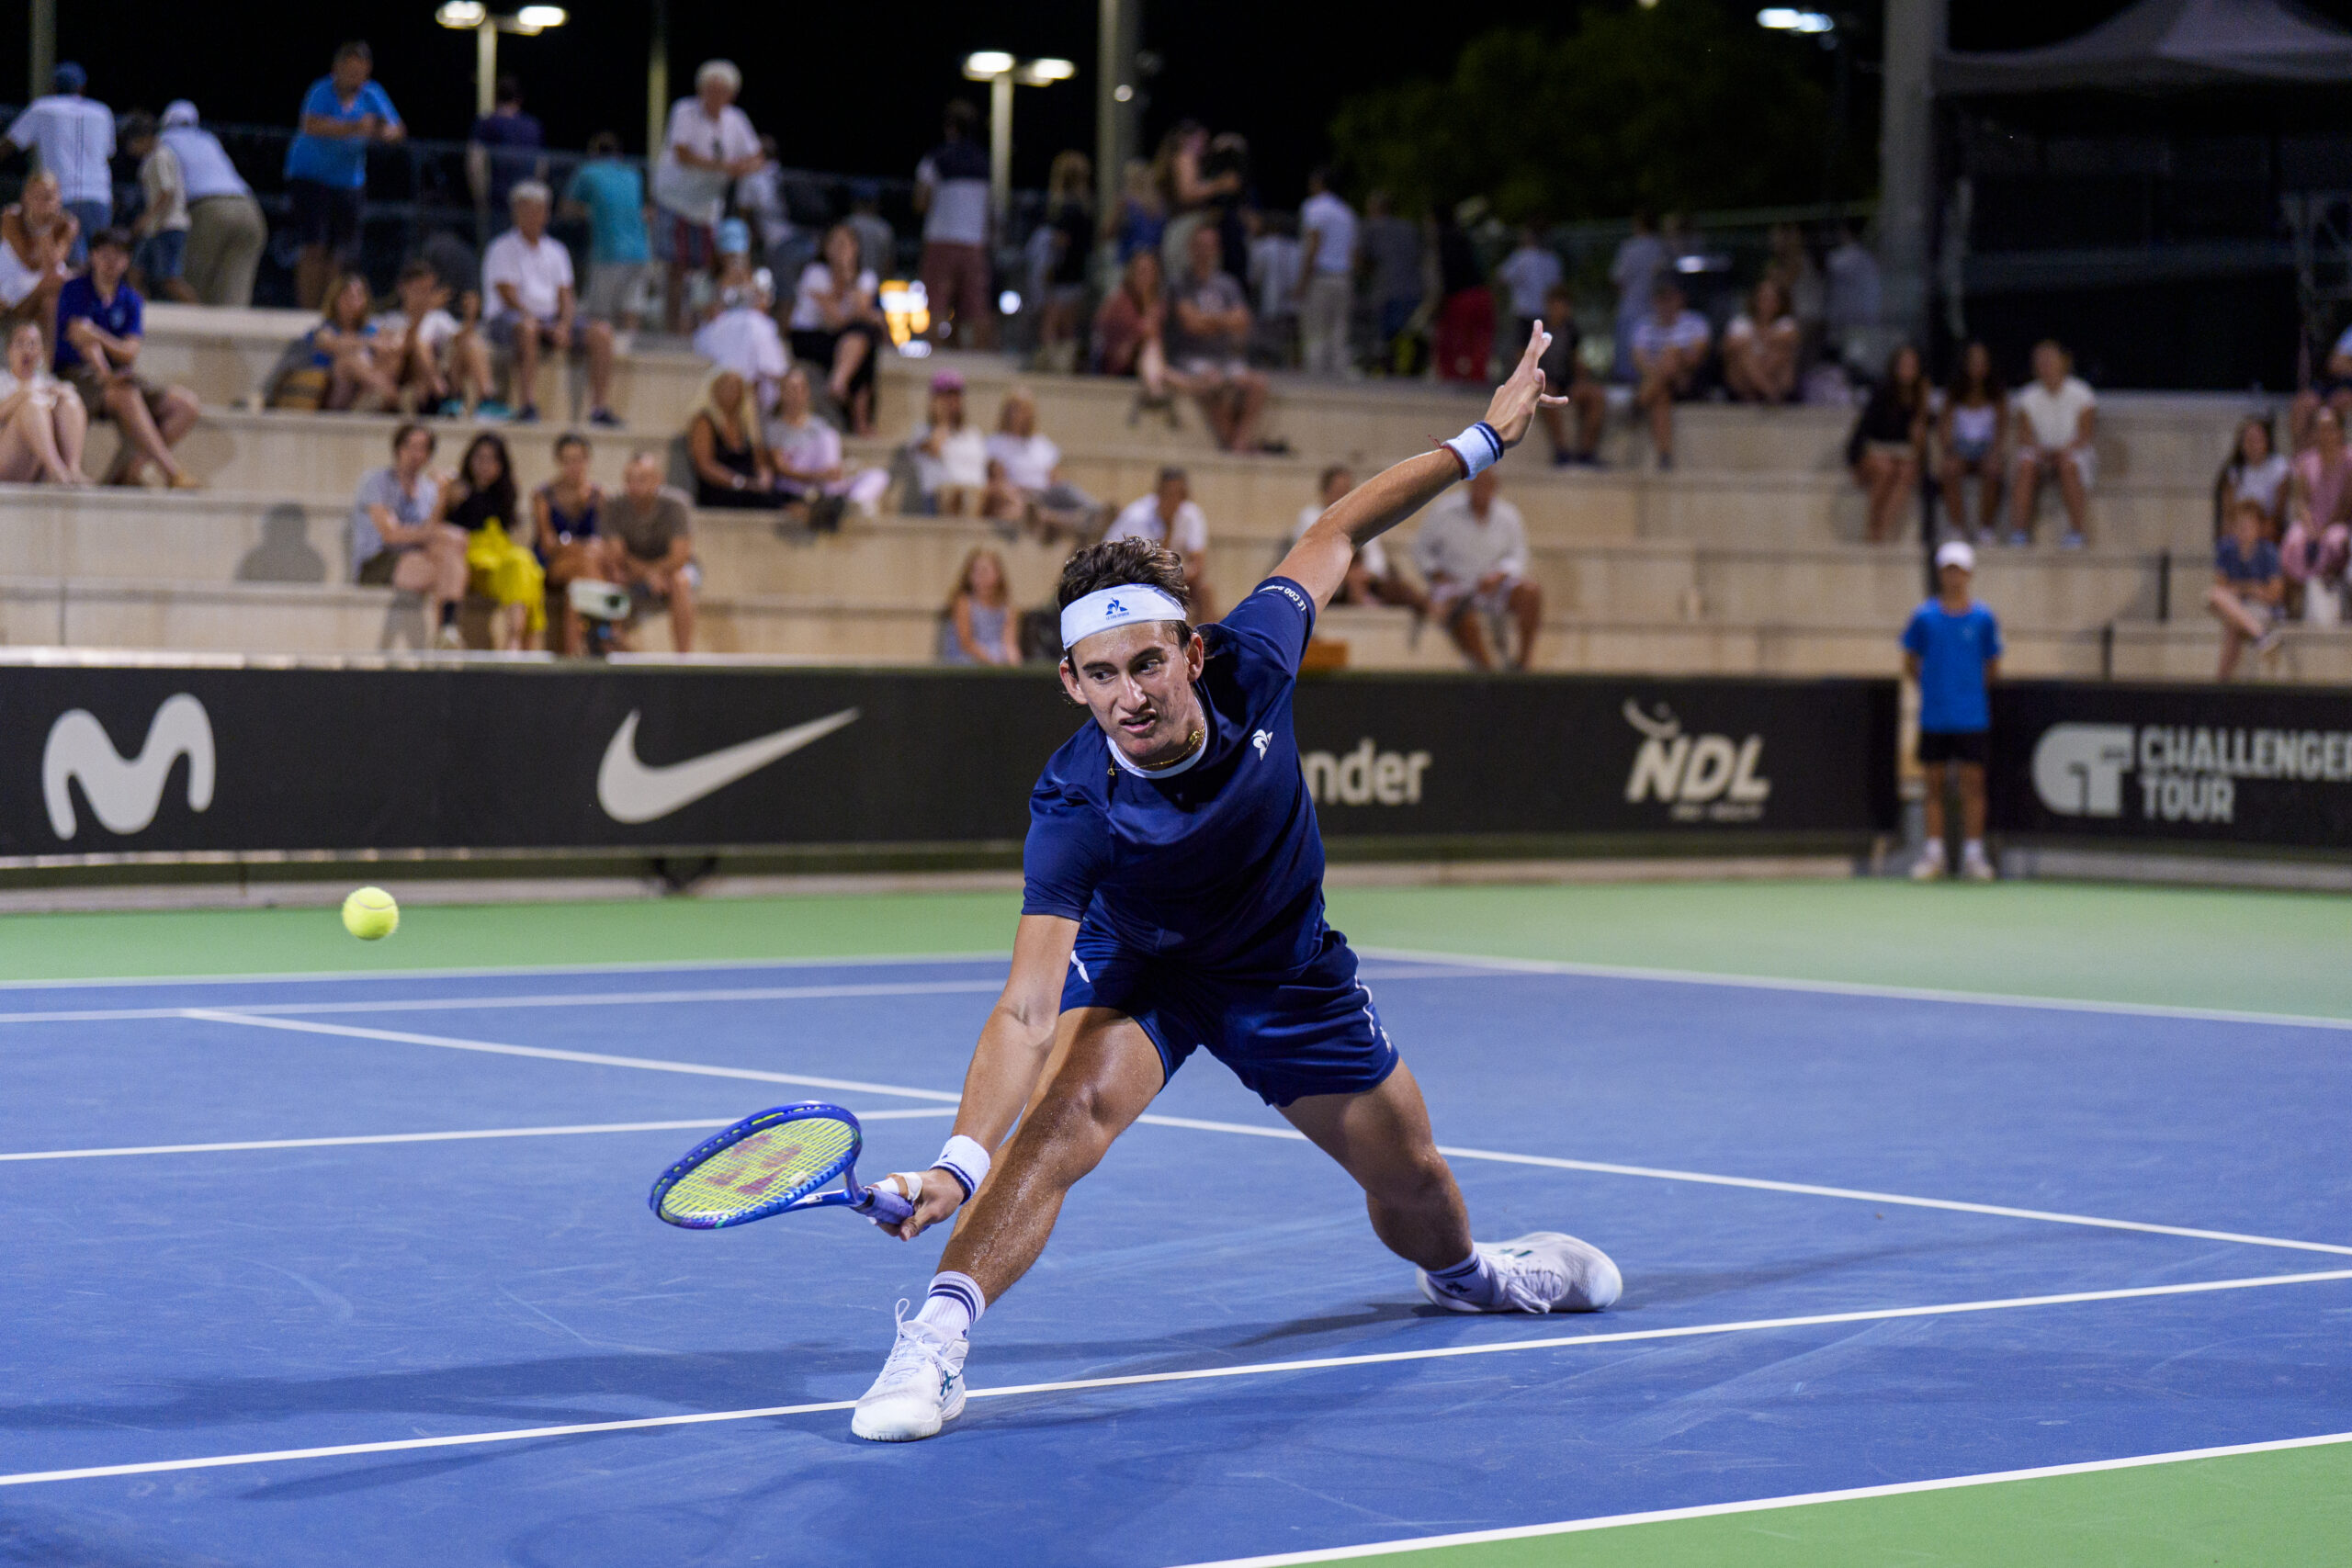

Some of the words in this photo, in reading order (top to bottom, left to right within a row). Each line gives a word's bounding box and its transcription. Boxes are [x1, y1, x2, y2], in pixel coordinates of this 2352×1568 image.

[1296, 599, 1306, 611] LE
[1301, 738, 1431, 806] nder
[1625, 734, 1770, 803] NDL
[2141, 776, 2234, 823] TOUR
